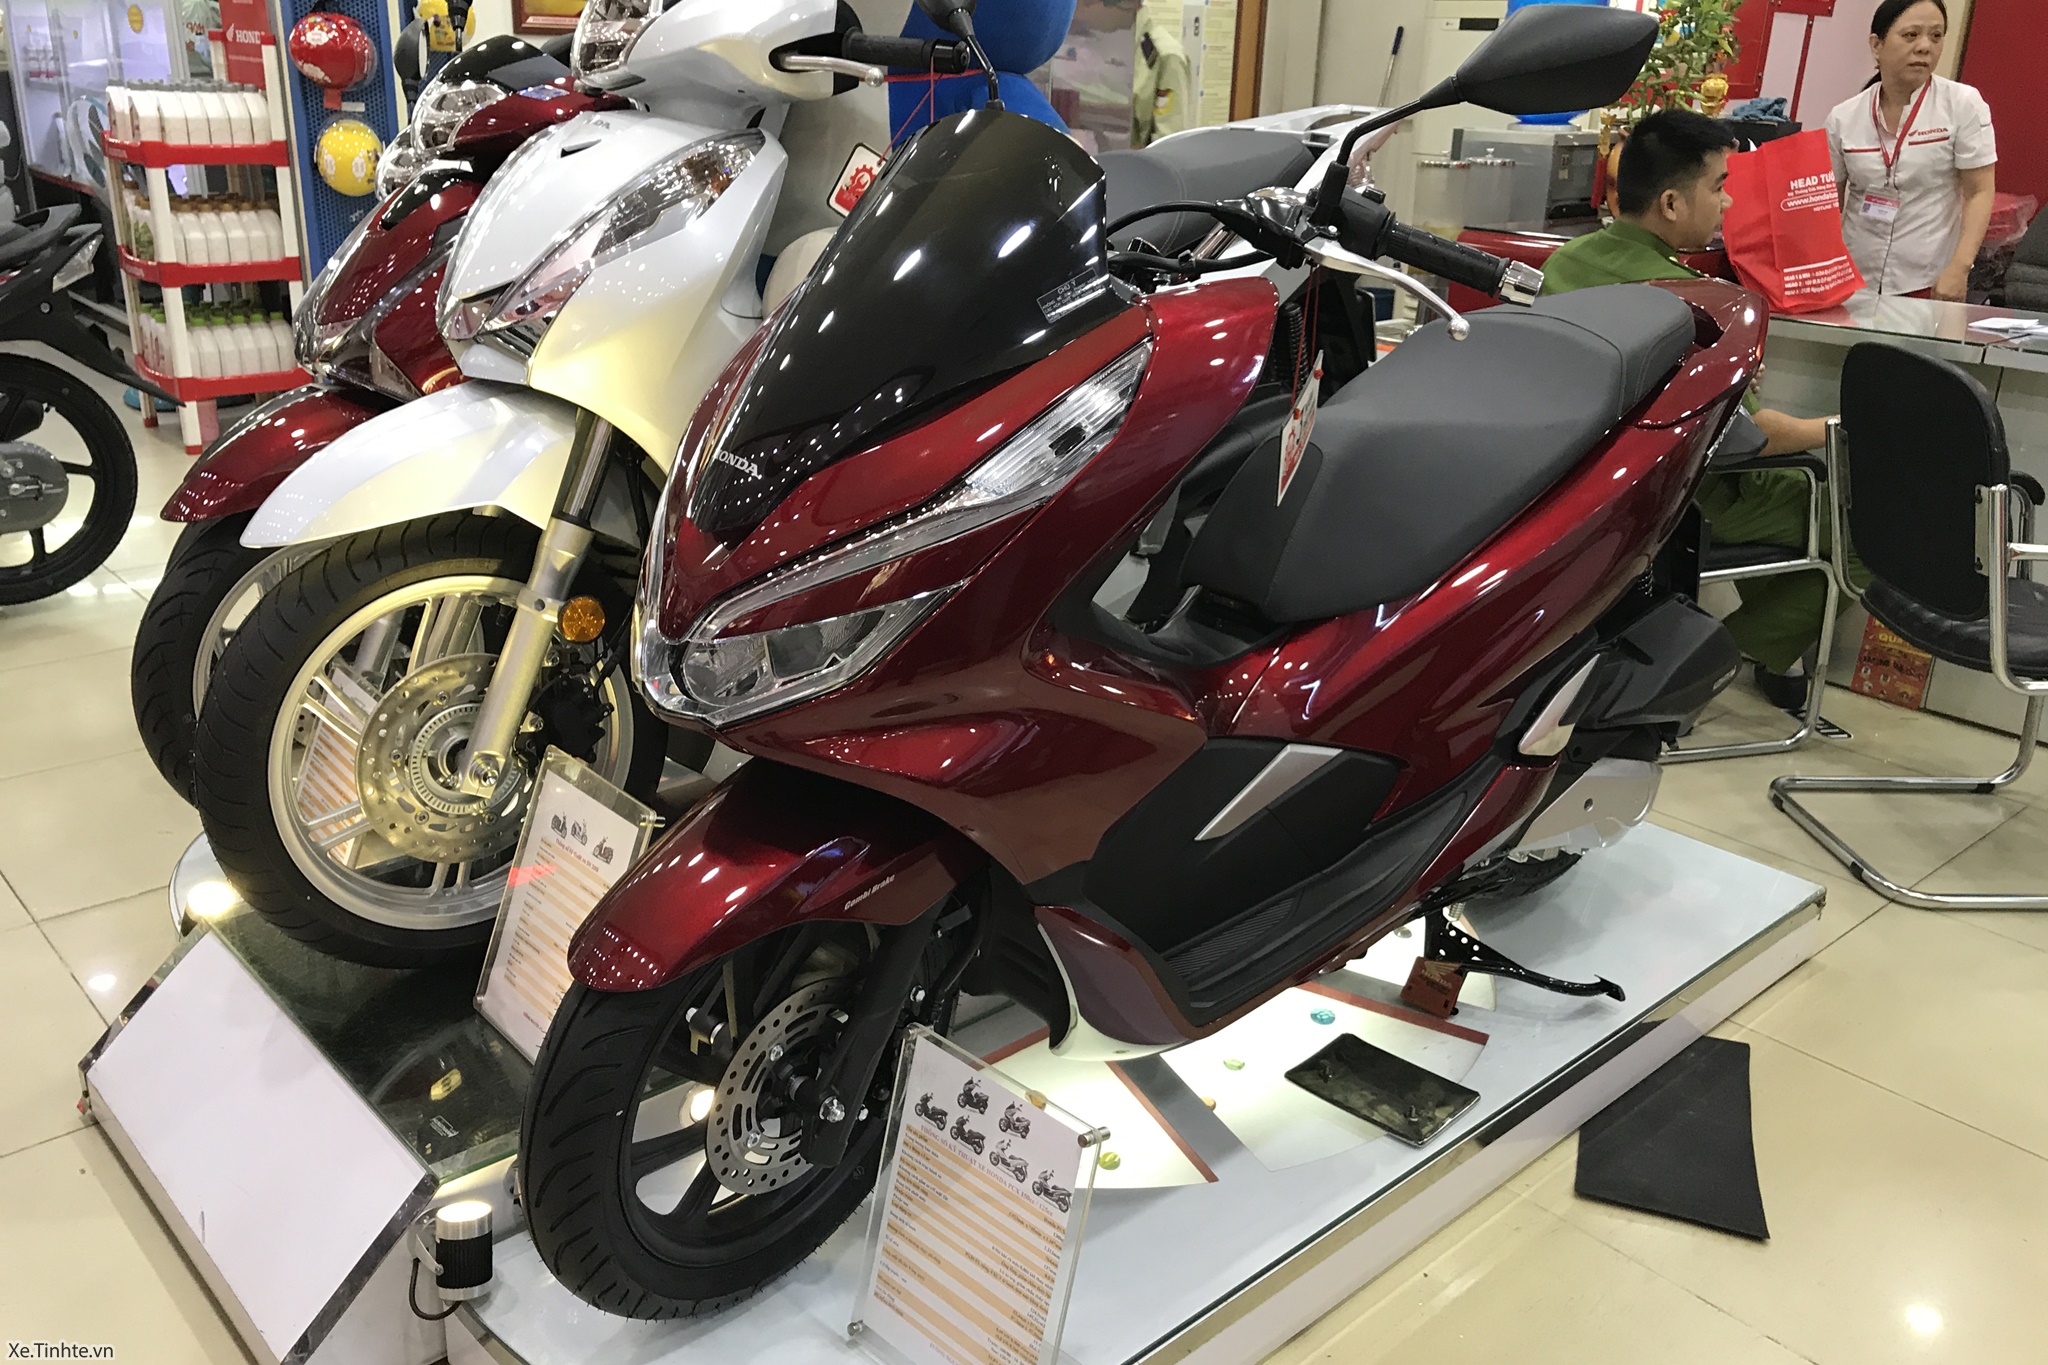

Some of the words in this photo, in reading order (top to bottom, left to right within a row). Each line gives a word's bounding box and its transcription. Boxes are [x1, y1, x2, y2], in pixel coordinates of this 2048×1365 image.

[1917, 127, 1948, 137] HONDA
[1790, 177, 1818, 190] HEAD
[844, 888, 871, 910] Combi
[871, 874, 895, 894] Brake
[987, 1168, 1008, 1187] HONDA
[1008, 1182, 1021, 1196] PCX
